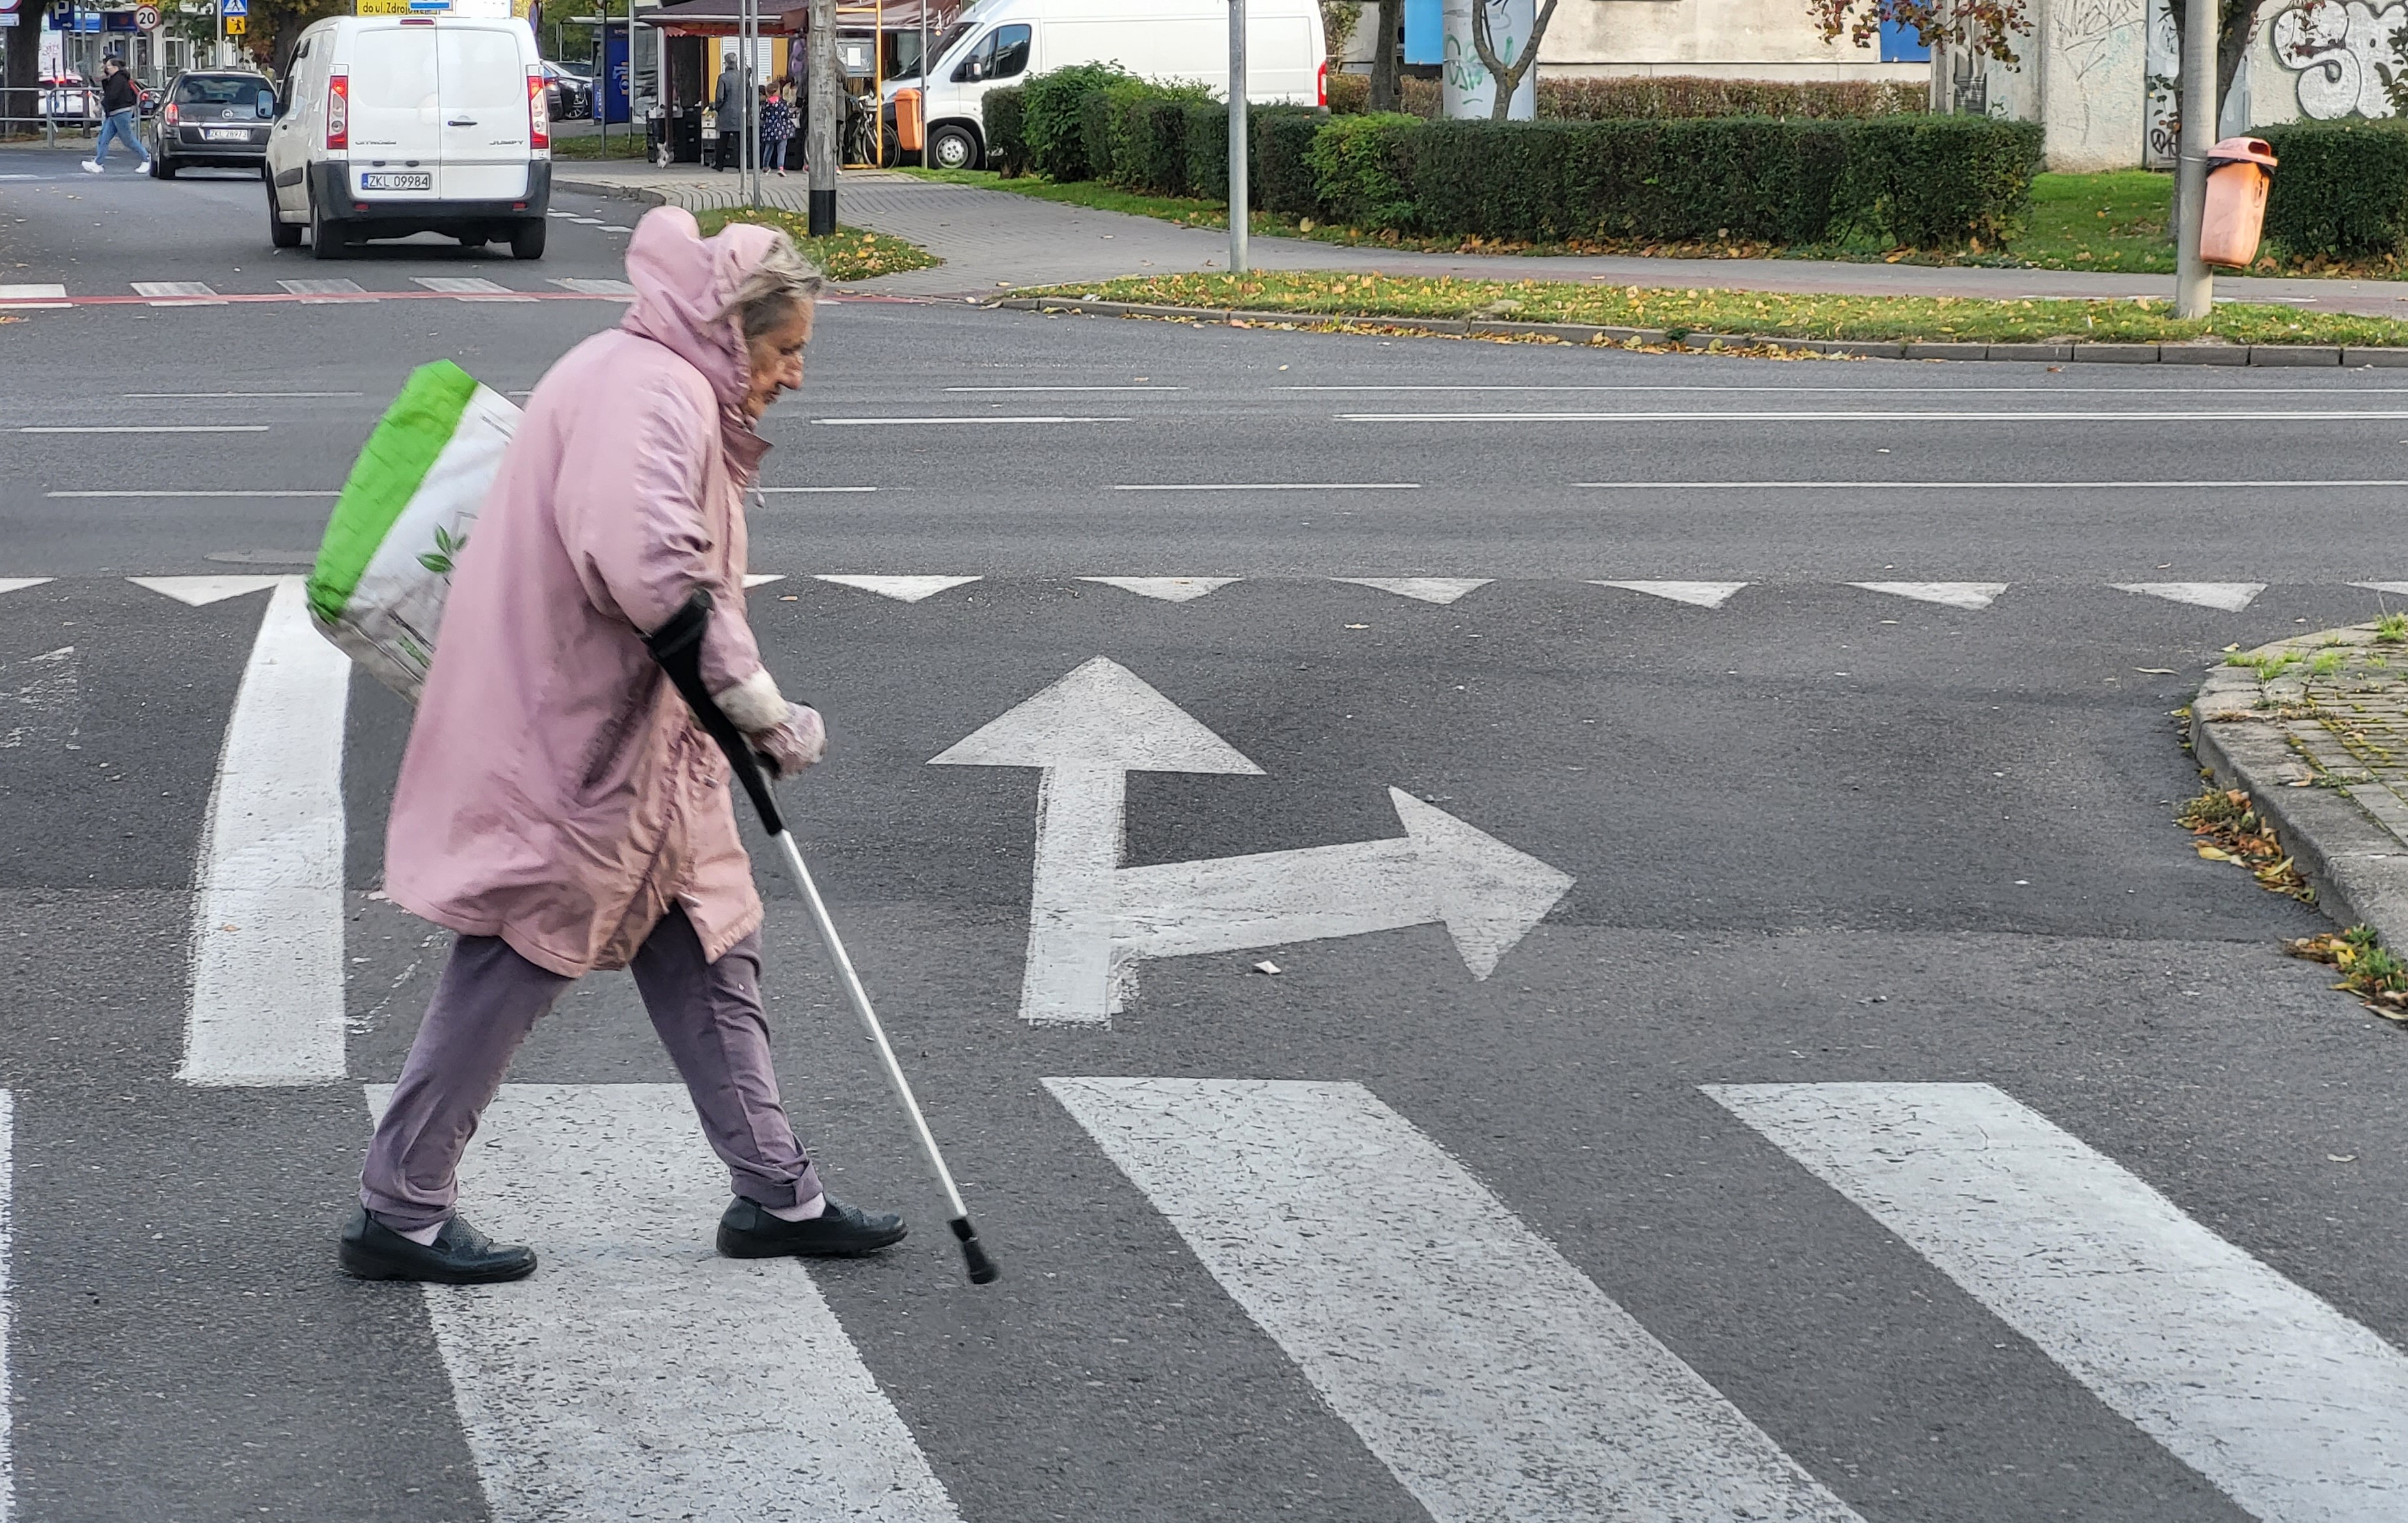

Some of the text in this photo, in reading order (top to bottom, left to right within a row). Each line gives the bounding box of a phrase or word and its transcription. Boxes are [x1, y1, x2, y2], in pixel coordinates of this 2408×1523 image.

[363, 3, 374, 13] do
[139, 12, 156, 25] 20
[369, 174, 428, 187] ZKL 09984
